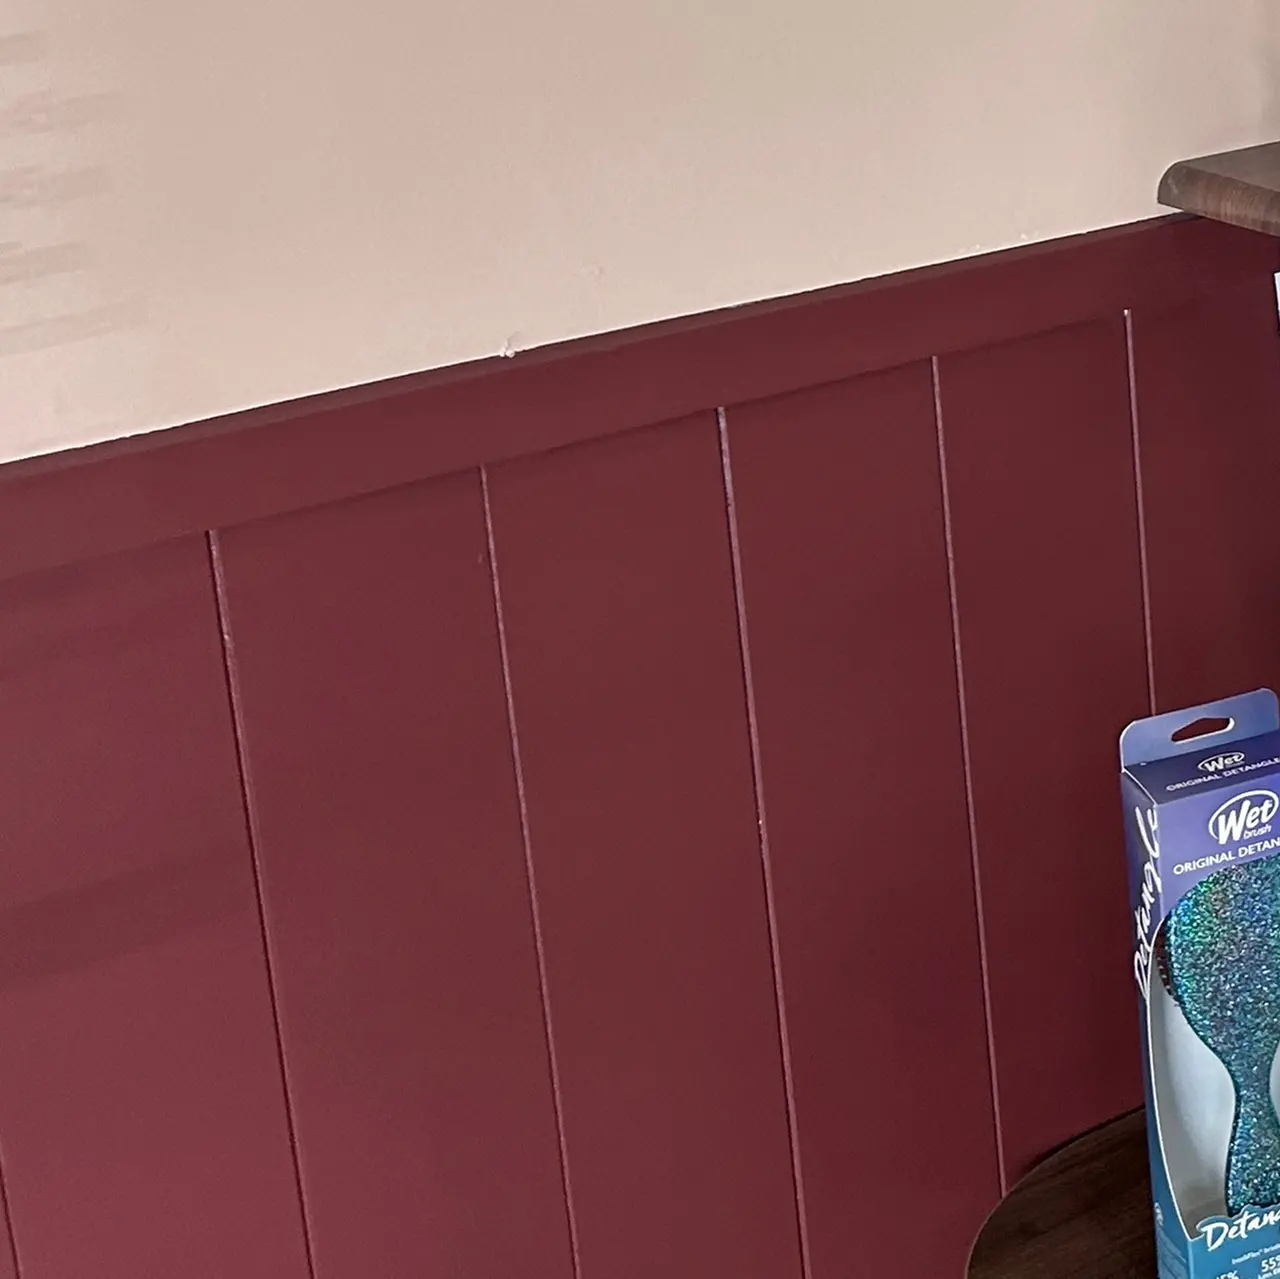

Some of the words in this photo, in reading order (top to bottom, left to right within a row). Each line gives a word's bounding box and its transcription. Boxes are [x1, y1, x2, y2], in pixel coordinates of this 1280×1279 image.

[1166, 773, 1223, 791] ORIGINAL
[1217, 799, 1272, 845] Wet
[1173, 851, 1236, 876] ORIGINAL
